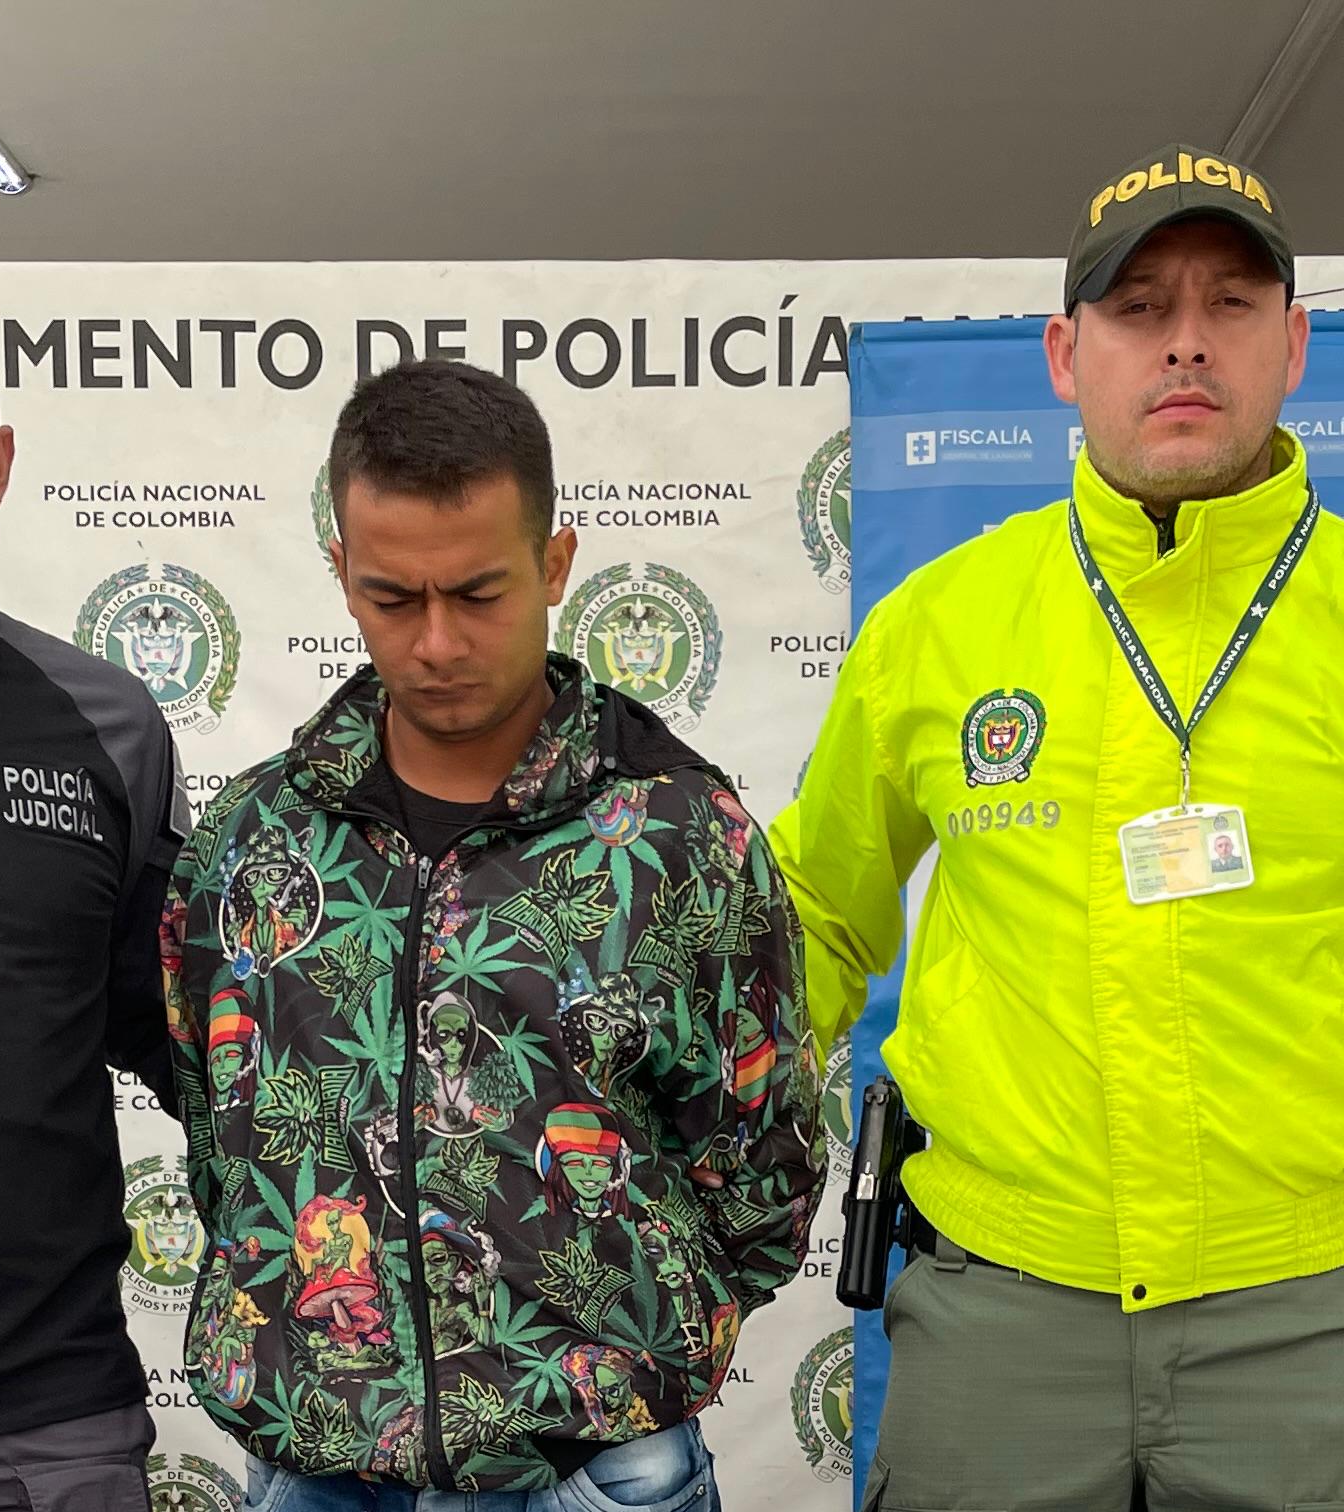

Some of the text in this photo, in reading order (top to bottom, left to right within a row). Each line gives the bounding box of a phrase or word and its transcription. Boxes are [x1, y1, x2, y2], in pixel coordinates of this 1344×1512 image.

[1089, 152, 1273, 227] POLICIA
[503, 294, 852, 388] POLICÍA
[940, 424, 1033, 447] FISCALÍA
[43, 481, 266, 502] POLICÍA NACIONAL
[555, 480, 752, 501] LICÍA NACIONAL
[819, 455, 852, 517] REPUBLIC
[75, 511, 235, 528] DE COLOMBIA
[560, 510, 720, 527] DE COLOMBIA
[148, 583, 167, 593] DE
[180, 590, 220, 660] COLOMBIA
[576, 582, 703, 659] REPUBLICA DE COLOMBIA
[287, 636, 365, 654] POLICÍ
[319, 664, 348, 679] DE
[800, 663, 830, 679] DE
[1107, 603, 1178, 729] POLICIA NACIONAL
[1199, 631, 1250, 708] NACIONAL
[167, 709, 203, 730] ATRIA
[3, 765, 96, 805] POLICÍA
[3, 800, 104, 842] JUDICIAL
[163, 1173, 181, 1183] DE
[804, 1263, 833, 1278] DE
[812, 1348, 853, 1412] REPUBLICA
[145, 1392, 201, 1408] COLO
[818, 1427, 853, 1459] POLICI
[167, 1471, 184, 1480] DE
[830, 1460, 853, 1476] DIO
